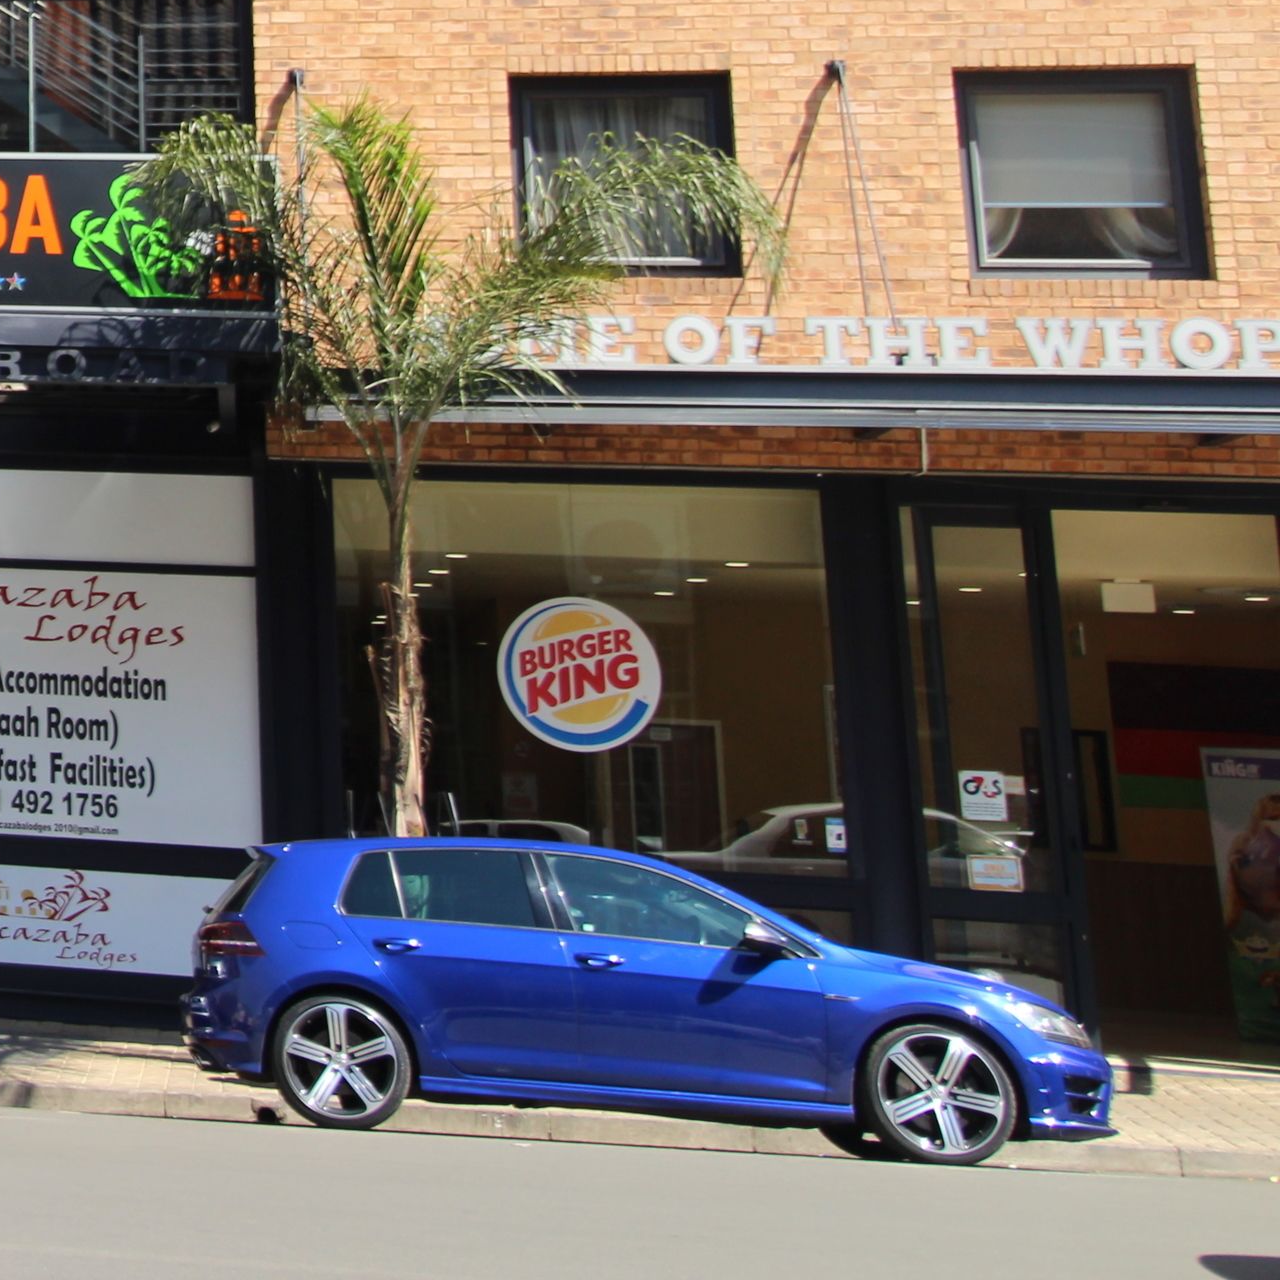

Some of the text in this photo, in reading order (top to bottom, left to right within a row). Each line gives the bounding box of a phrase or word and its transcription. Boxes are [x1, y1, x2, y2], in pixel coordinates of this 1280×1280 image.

[663, 314, 776, 365] OF
[805, 316, 990, 367] THE
[23, 615, 185, 664] Lodges
[519, 629, 633, 677] BURGER
[526, 653, 640, 714] KING
[46, 707, 119, 749] Room)
[49, 752, 155, 797] Facilities)
[11, 790, 53, 815] 492
[63, 792, 118, 818] 1756
[56, 946, 137, 969] Lodges
